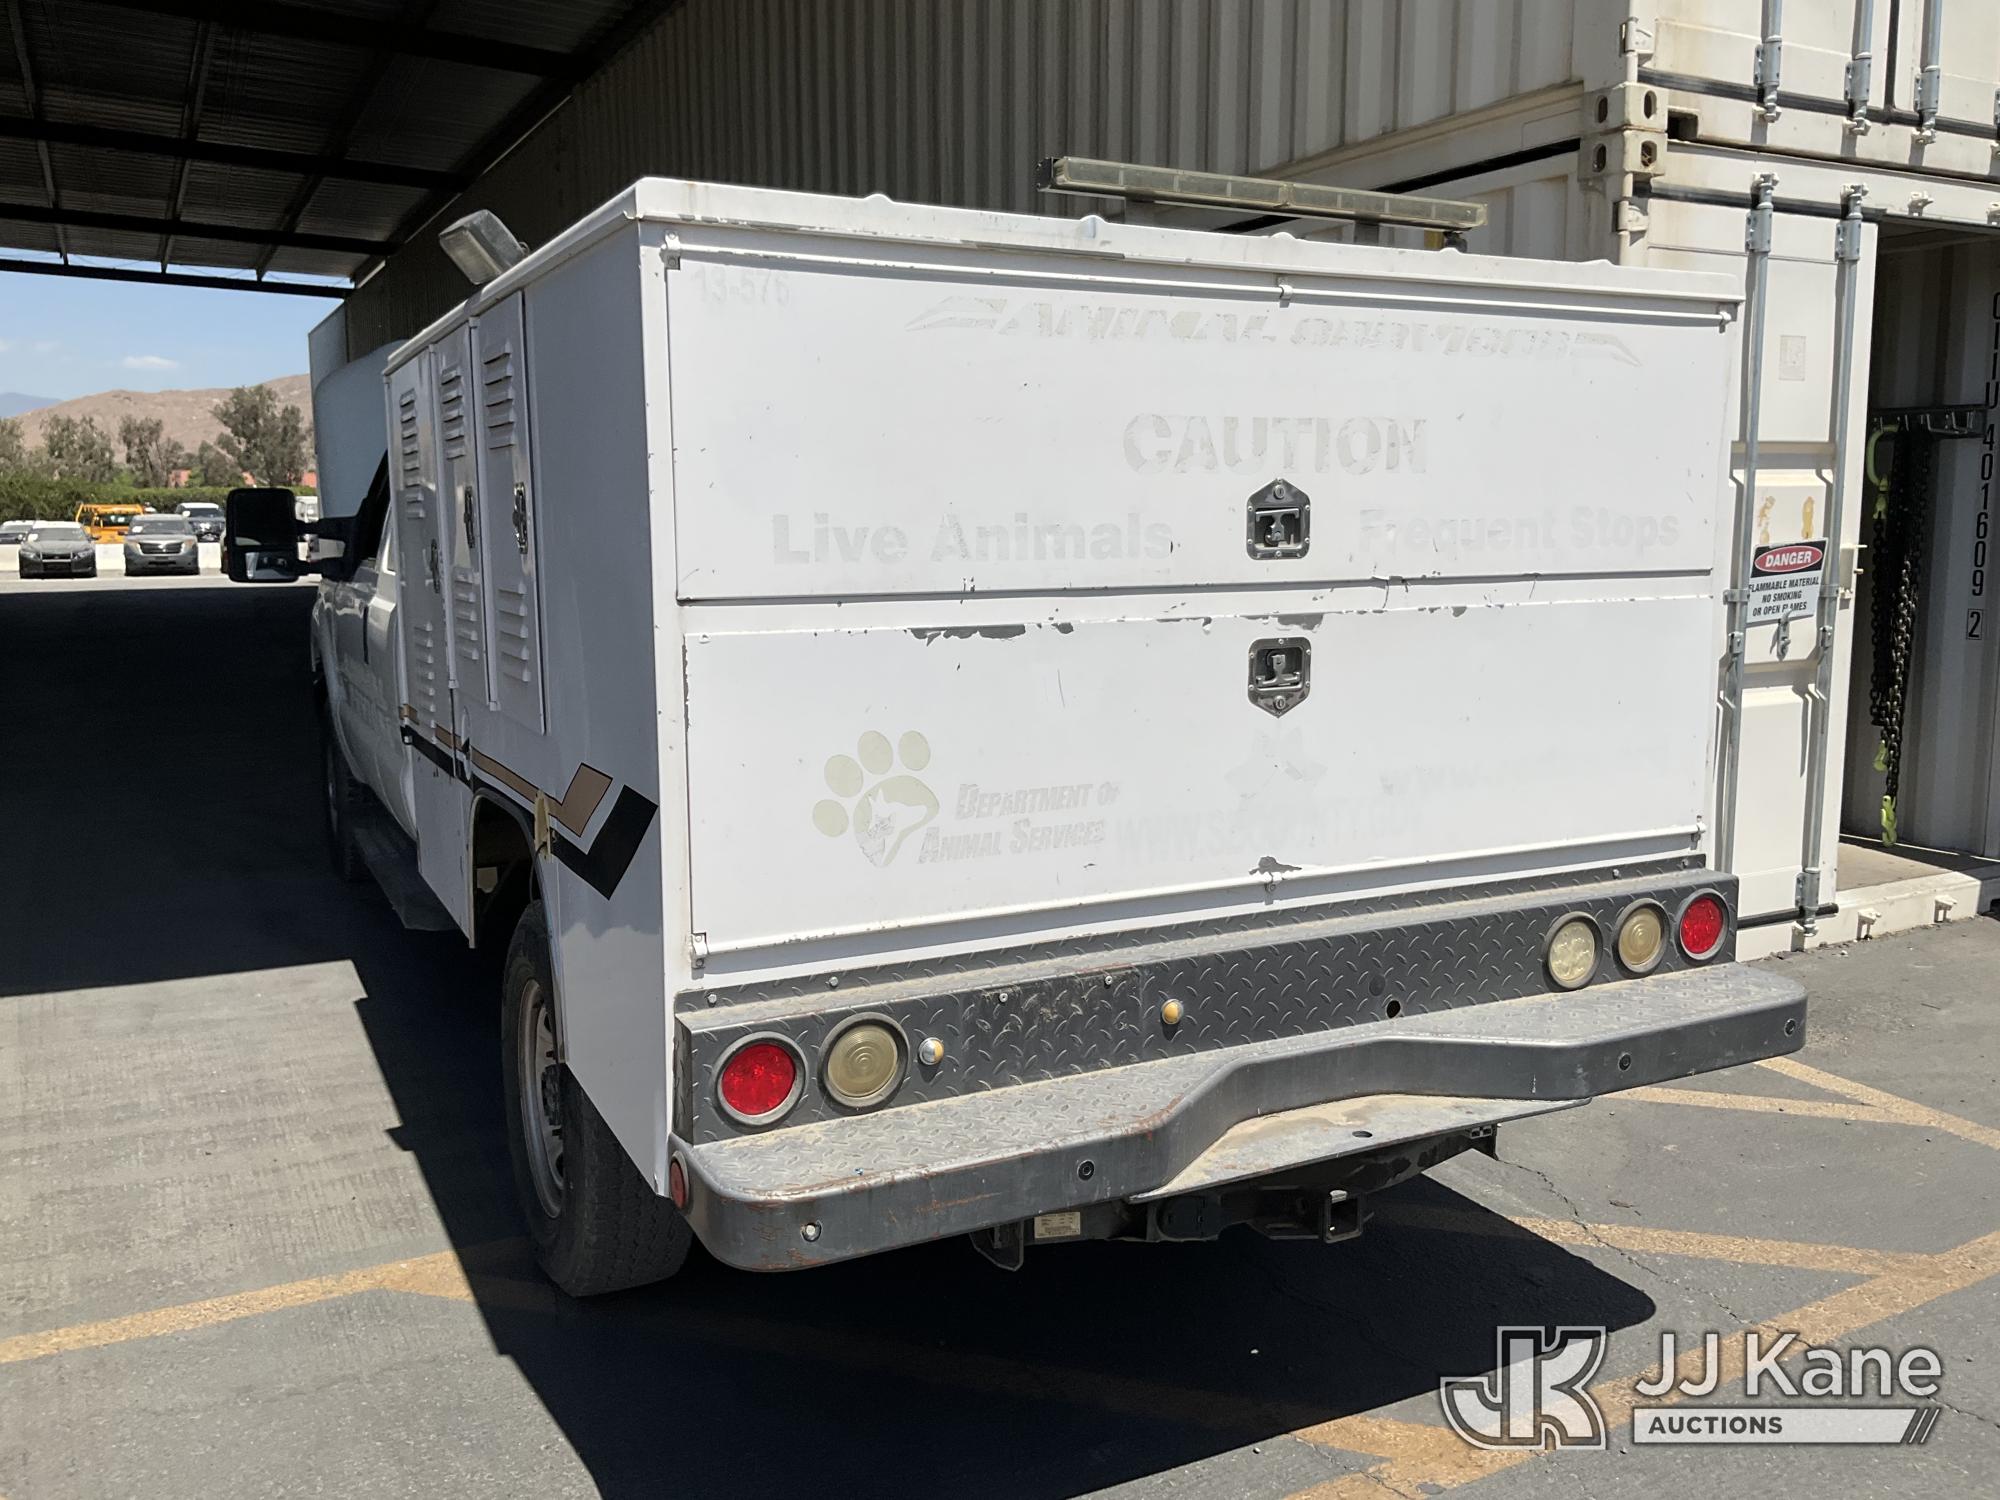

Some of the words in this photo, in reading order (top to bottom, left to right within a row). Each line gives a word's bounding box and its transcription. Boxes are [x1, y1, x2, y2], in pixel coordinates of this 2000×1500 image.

[1122, 413, 1428, 475] CAUTION
[1972, 424, 1995, 596] 401609
[772, 511, 910, 564] Live
[929, 511, 1174, 562] Animals
[1359, 506, 1556, 561] Frequent
[1570, 505, 1681, 557] Stops
[1764, 551, 1812, 568] DANGER
[1762, 594, 1772, 603] NO
[1773, 591, 1802, 602] SMOKING
[1788, 577, 1819, 588] MATERIAL
[1753, 607, 1762, 616] OR
[1763, 605, 1780, 615] OPEN
[1967, 611, 1981, 638] 2
[917, 826, 1002, 864] ANIMAL
[1008, 817, 1107, 855] SERVICES
